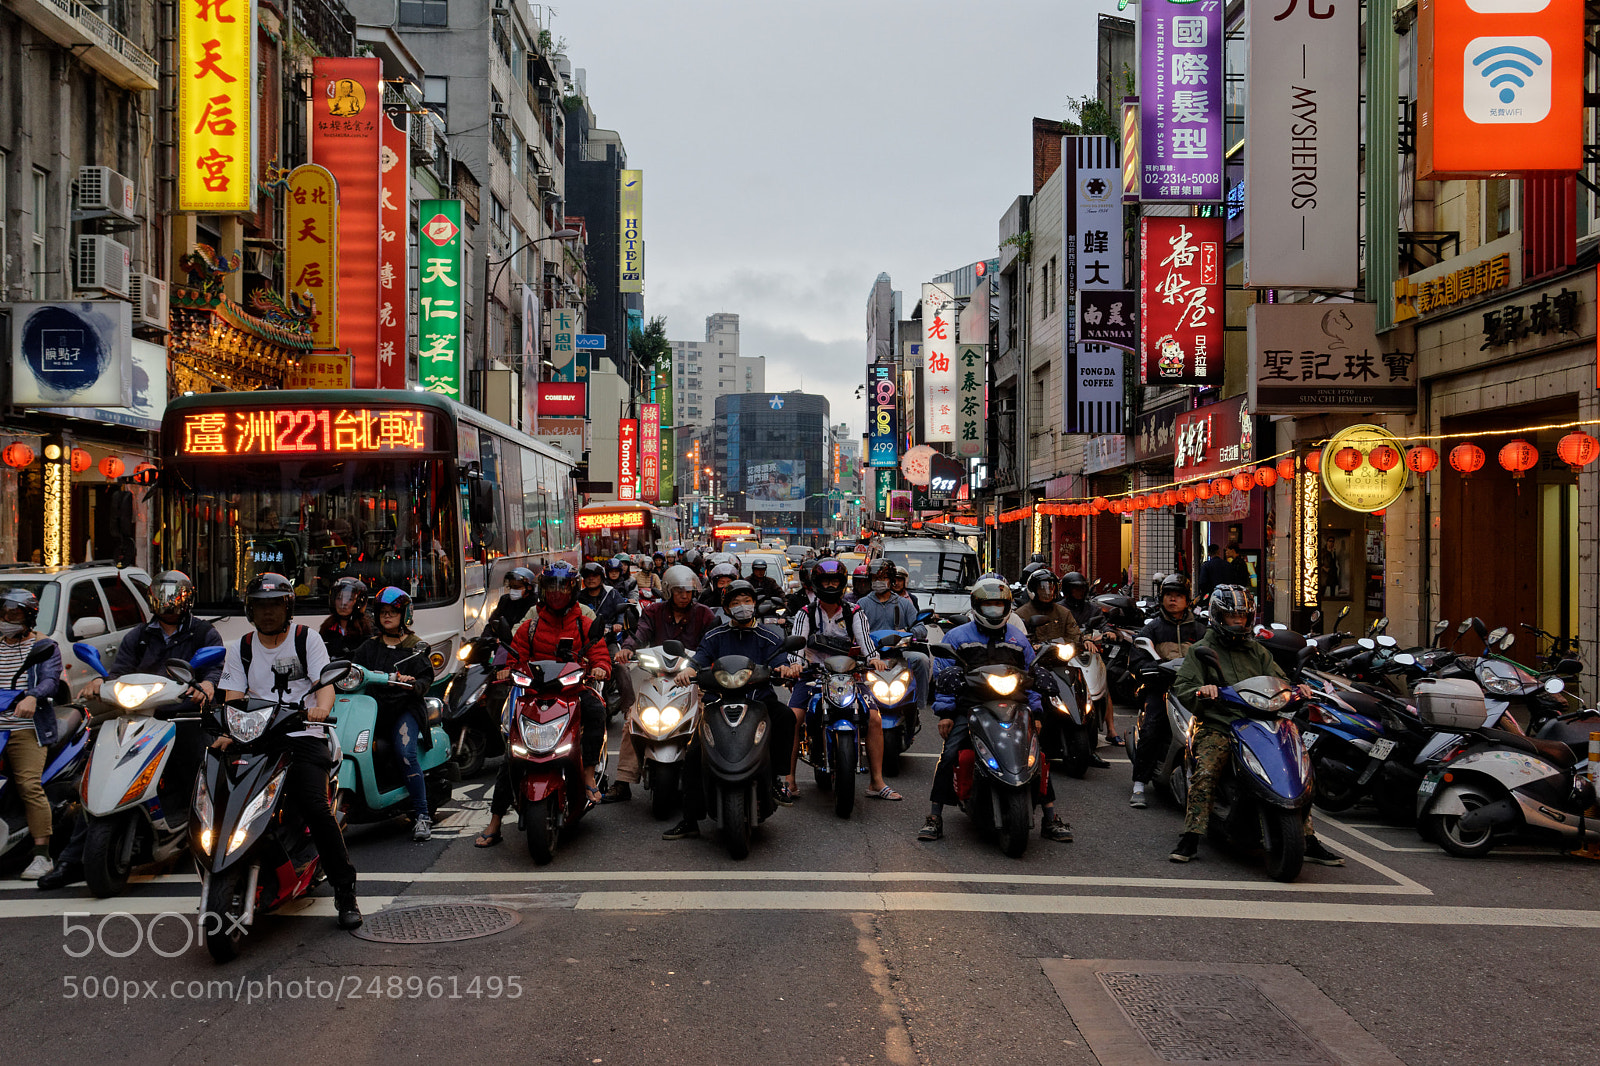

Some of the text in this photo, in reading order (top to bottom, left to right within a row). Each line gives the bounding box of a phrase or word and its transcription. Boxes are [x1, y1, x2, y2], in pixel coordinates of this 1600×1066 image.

[1171, 16, 1209, 159] 國際髮型
[1489, 108, 1523, 117] 免費WiFi
[1291, 86, 1317, 210] MYSHEROS
[1145, 173, 1219, 184] 02-2314-5008
[293, 186, 327, 205] 台北
[1159, 186, 1202, 196] 名留集團
[625, 219, 639, 272] HOTEL
[1417, 253, 1511, 314] 義法創意廚房
[418, 257, 458, 394] 天仁茗茶
[1084, 302, 1136, 327] 南美
[554, 313, 572, 351] 卡恩
[577, 338, 599, 346] vivo
[1088, 330, 1134, 338] NANMAY
[928, 317, 950, 374] 老抽
[1194, 335, 1207, 377] 日式拉麵
[1080, 367, 1116, 376] FONG DA
[1258, 349, 1416, 382] 聖記珠寶
[1082, 379, 1114, 387] COFFEE
[1300, 395, 1375, 403] SUN CHI JEWELRY
[872, 442, 894, 454] 499
[621, 438, 633, 484] Tomod's
[931, 476, 957, 490] 988
